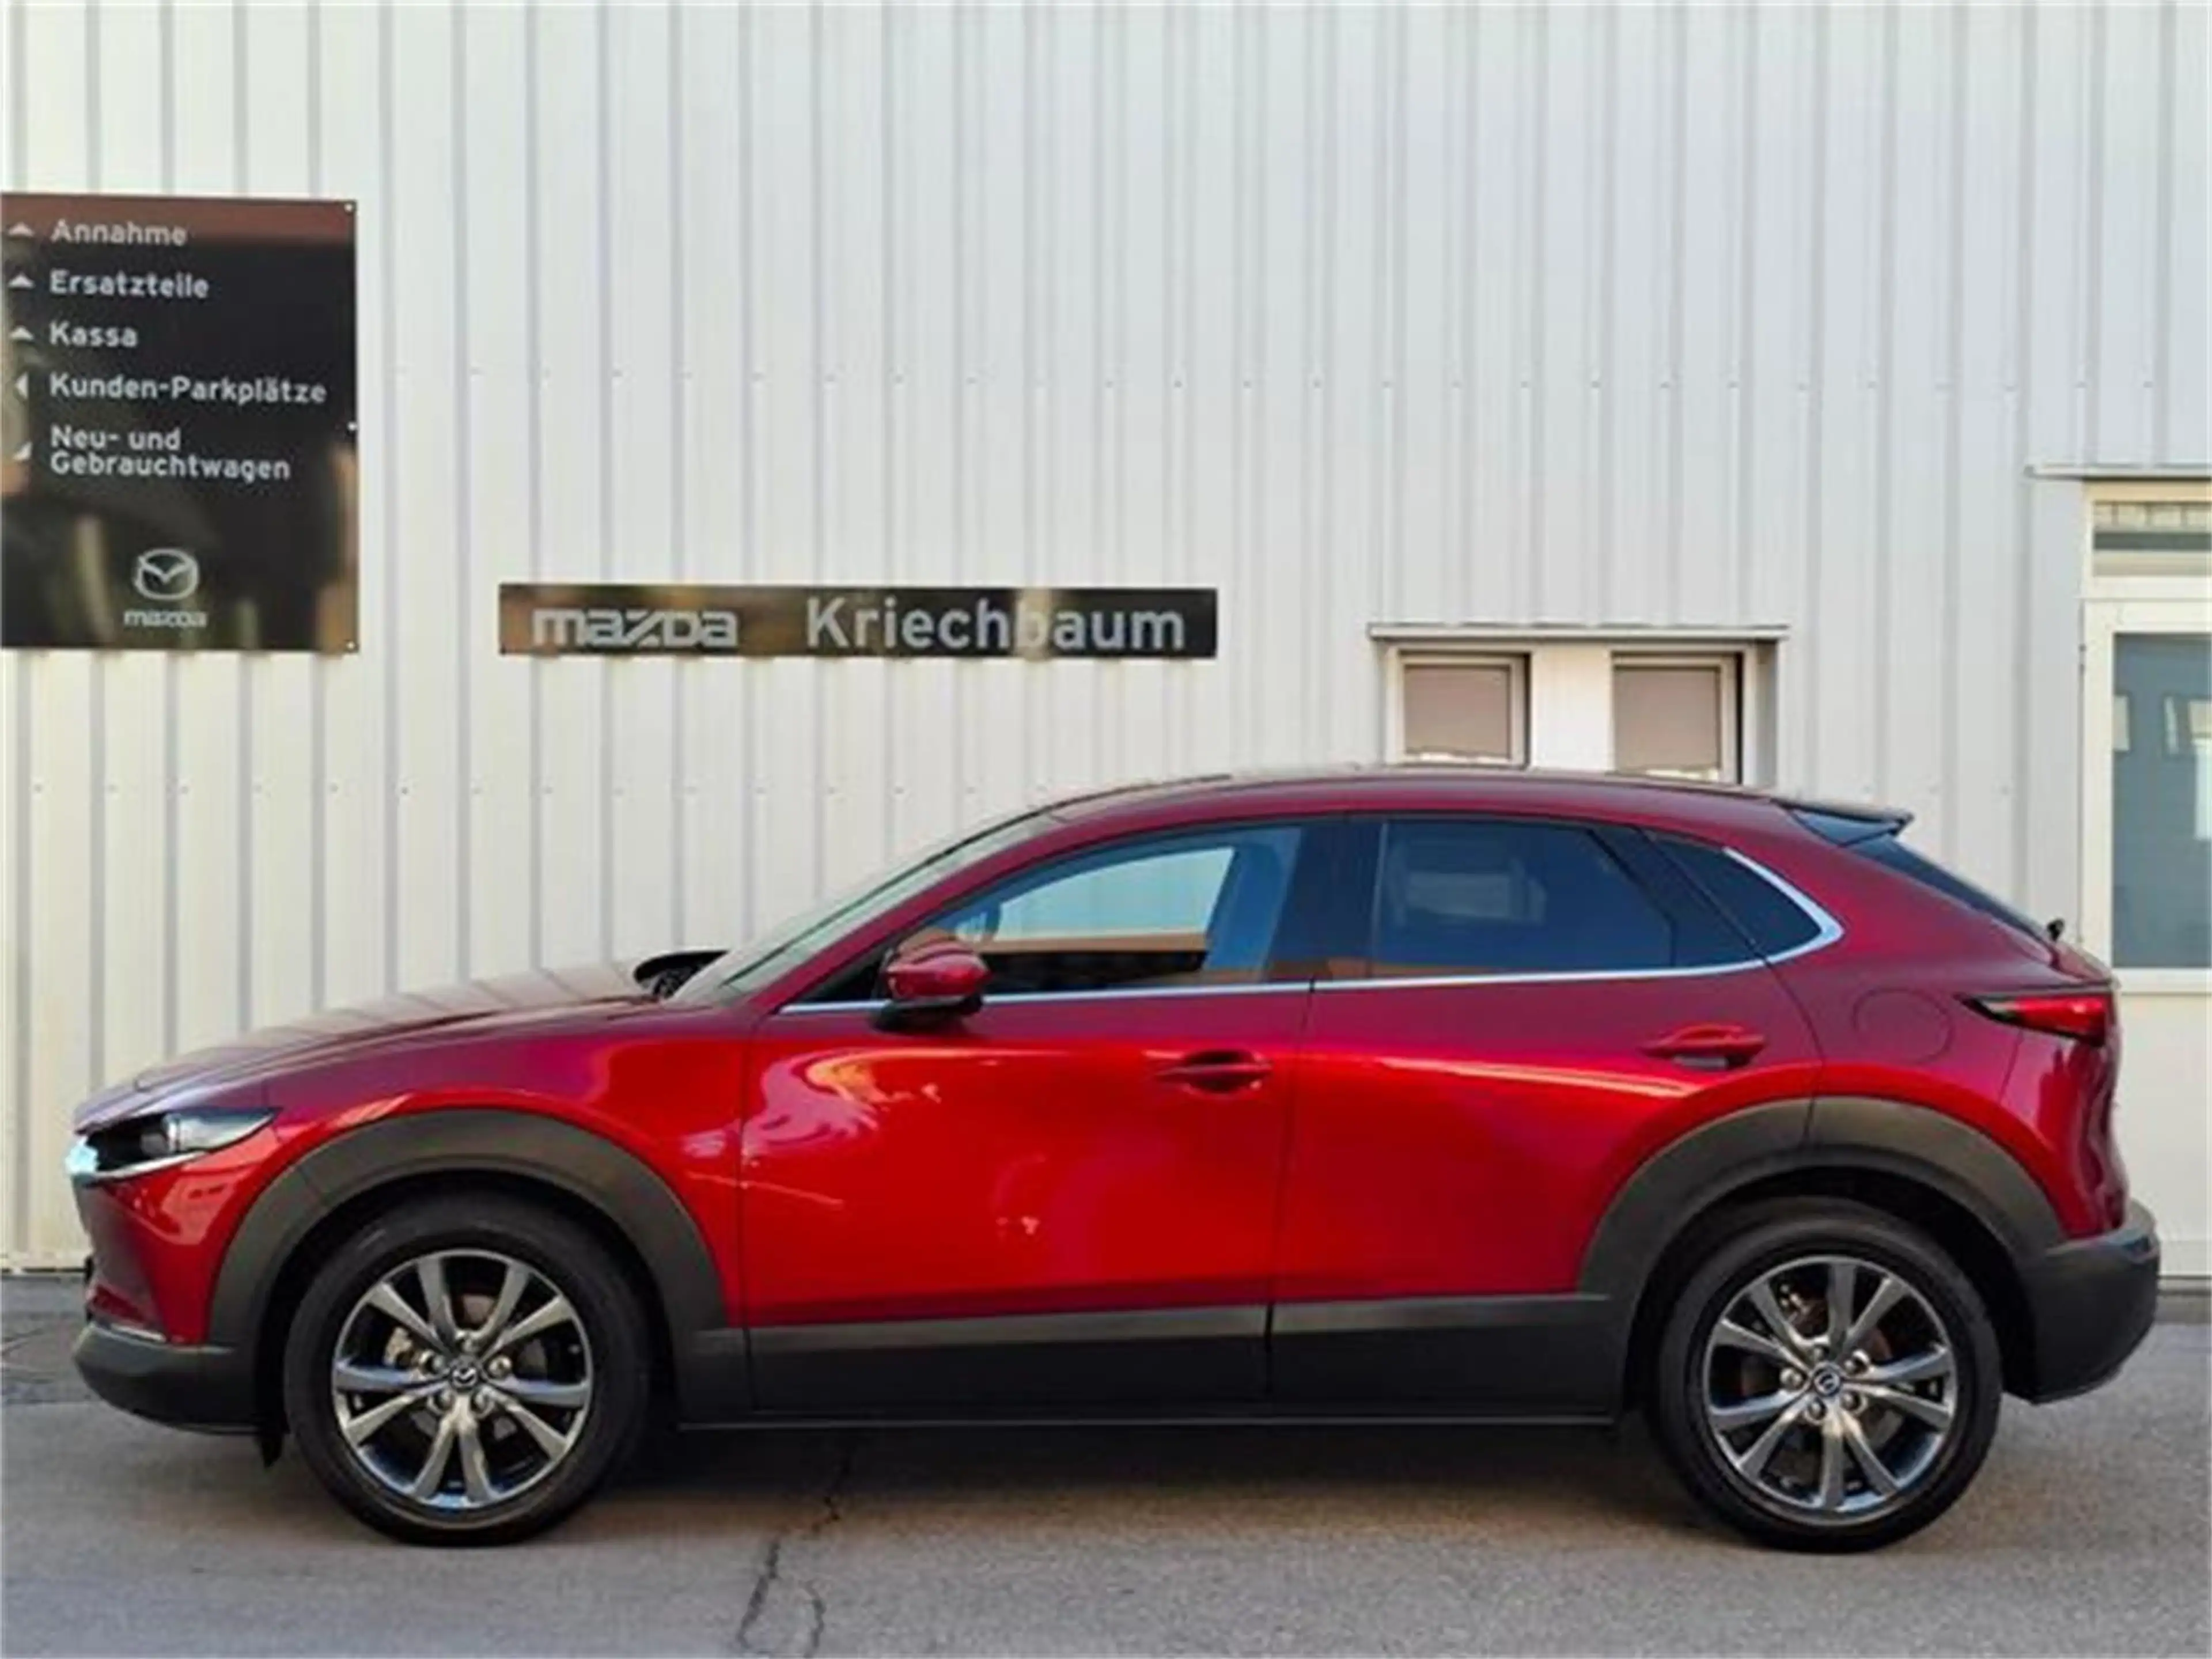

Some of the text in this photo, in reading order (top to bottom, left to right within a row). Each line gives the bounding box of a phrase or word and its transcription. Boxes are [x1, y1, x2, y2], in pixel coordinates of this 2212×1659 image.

[50, 219, 187, 246] Annahme
[50, 268, 210, 297] Ersatzteile
[50, 321, 138, 347] Kassa
[49, 372, 327, 405] Kunden-Parkplätze
[50, 425, 181, 450] Neu- und
[50, 452, 291, 482] Gebrauchtwagen
[807, 596, 1185, 650] Kriechbaum
